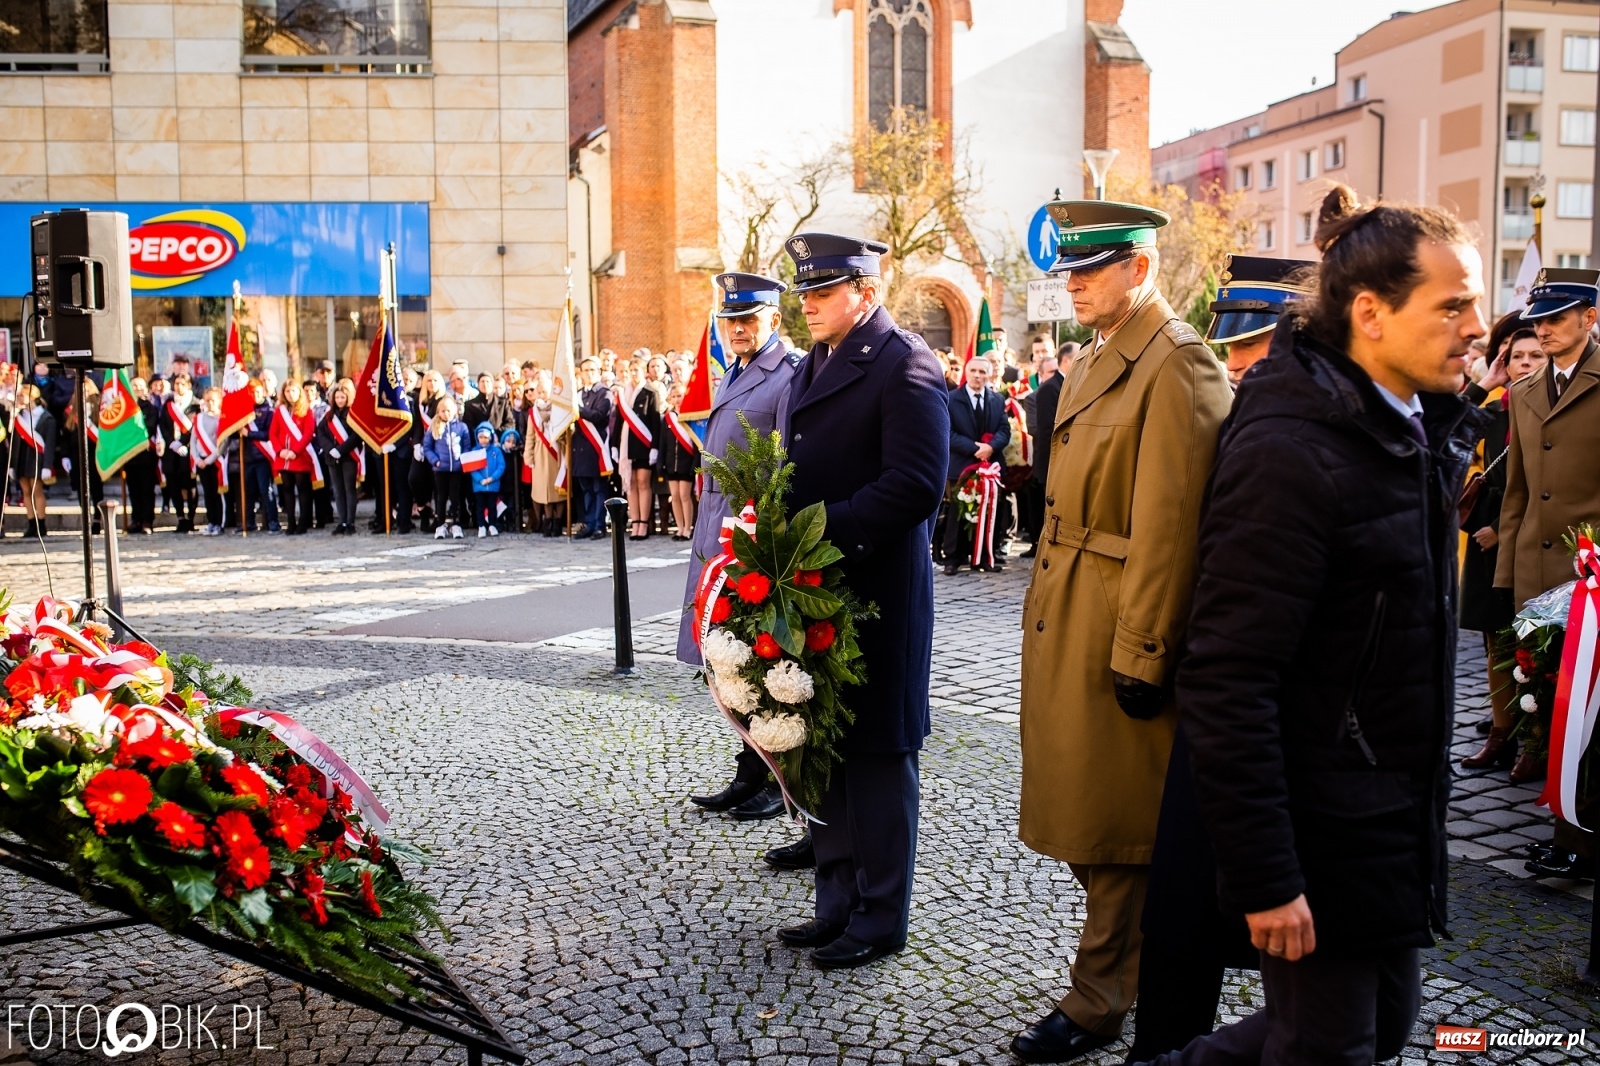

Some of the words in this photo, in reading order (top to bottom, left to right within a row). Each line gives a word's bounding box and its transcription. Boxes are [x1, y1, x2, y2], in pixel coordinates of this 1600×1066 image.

[129, 236, 223, 262] PEPCO
[1030, 283, 1041, 291] Nie
[1044, 281, 1067, 292] dotycz
